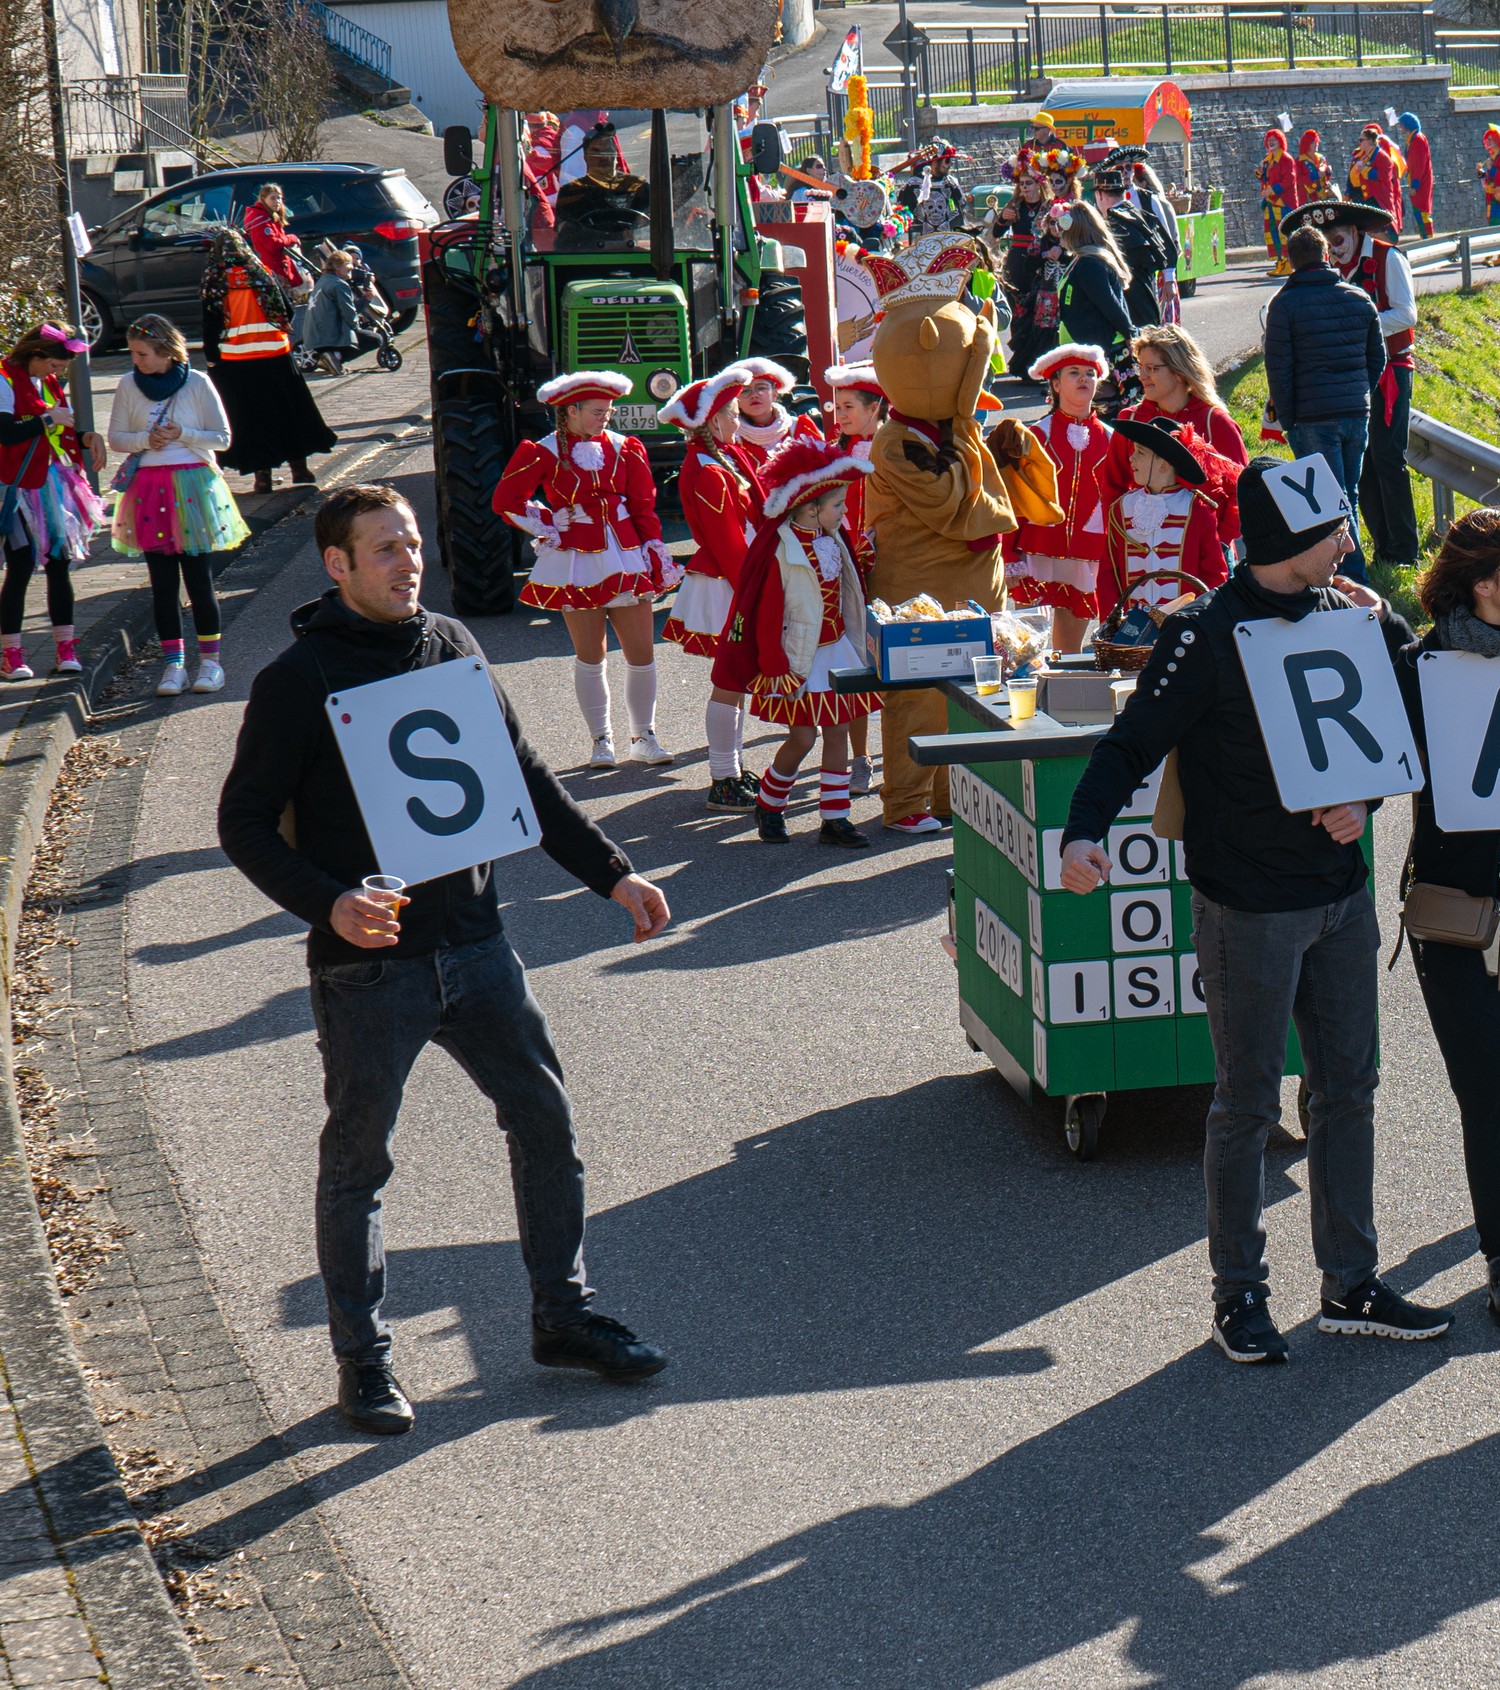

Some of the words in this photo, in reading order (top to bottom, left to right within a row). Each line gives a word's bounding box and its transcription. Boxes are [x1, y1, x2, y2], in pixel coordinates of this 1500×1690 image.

[1056, 128, 1129, 139] EIFELUCHS
[592, 296, 662, 304] DEUTZ
[620, 406, 644, 417] BIT
[631, 418, 655, 429] 979
[1280, 466, 1322, 515] Y
[1337, 498, 1350, 512] 4
[1283, 649, 1384, 772] R
[1397, 751, 1413, 780] 1
[388, 709, 485, 837] S
[511, 807, 529, 837] 1
[950, 766, 1035, 877] SCRABBLE
[978, 910, 1018, 985] 2023
